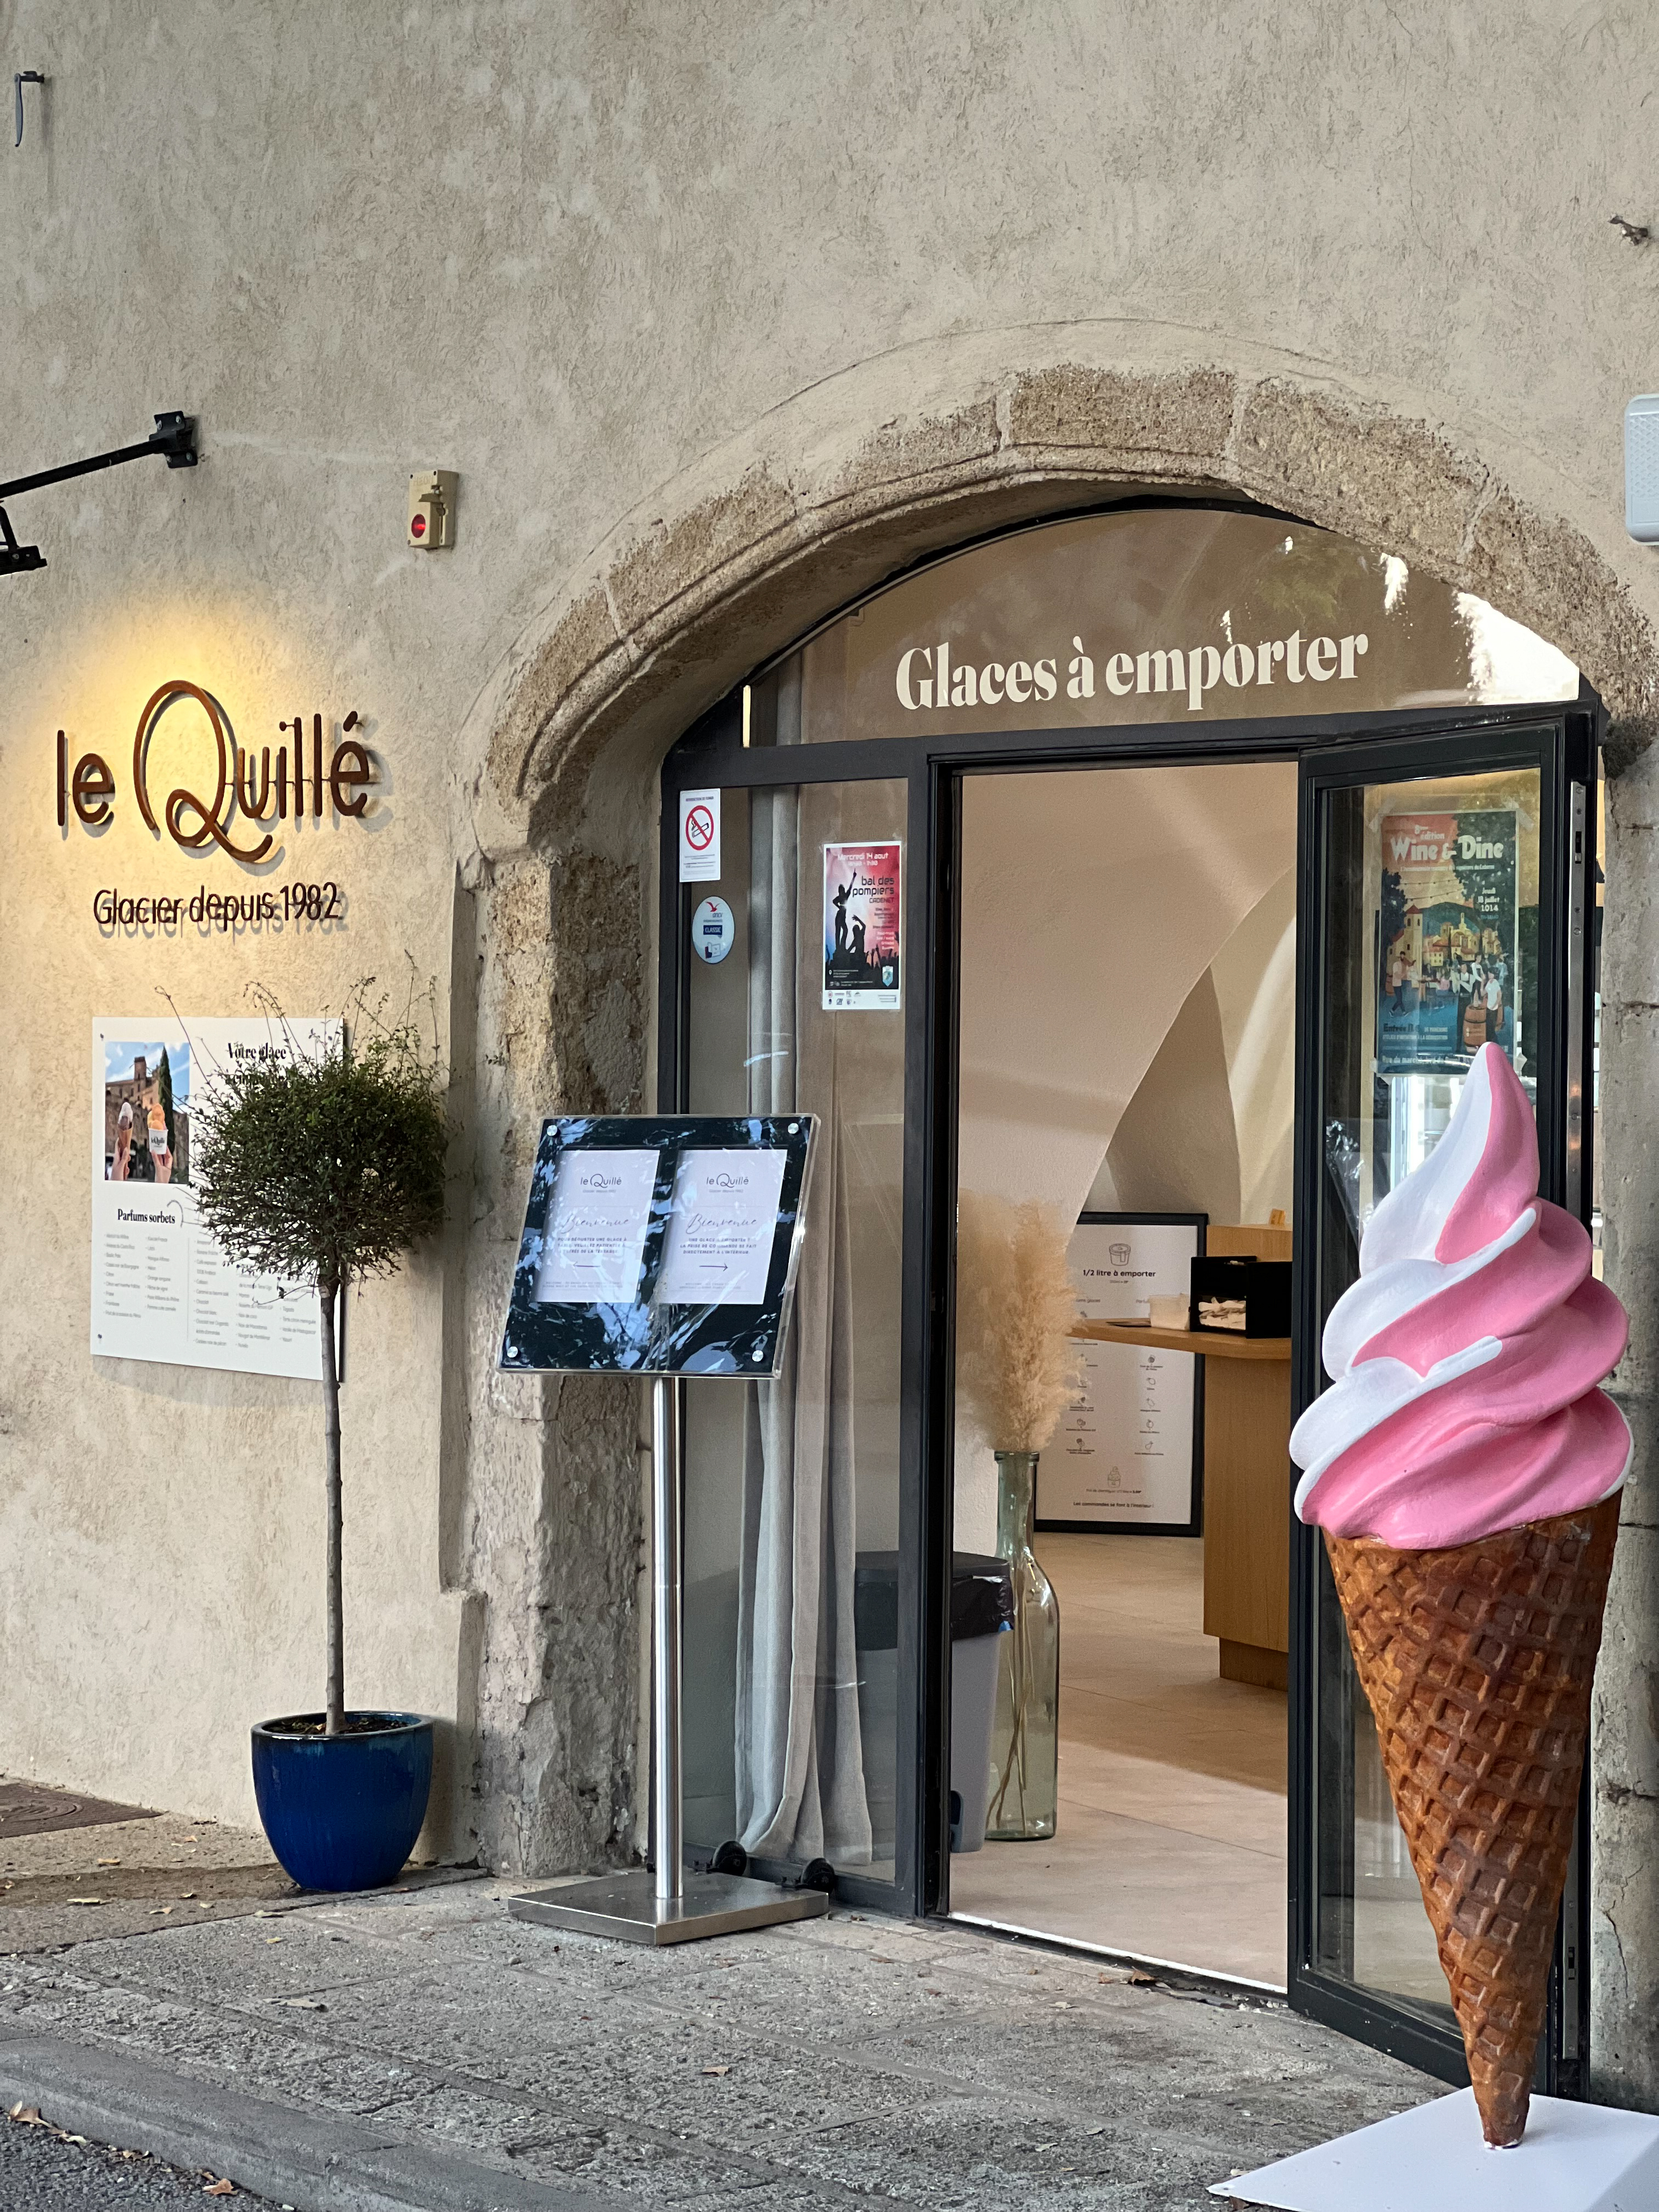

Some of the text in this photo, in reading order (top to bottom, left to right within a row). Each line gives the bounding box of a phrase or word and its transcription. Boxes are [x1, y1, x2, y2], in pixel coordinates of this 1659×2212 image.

[895, 629, 1369, 712] Glaces à emporter
[57, 679, 369, 862] le Quillé
[1390, 833, 1504, 862] Wine & Dine
[861, 875, 895, 885] bal des
[852, 884, 895, 898] pompiers
[94, 881, 338, 931] Glacier depuis 1982
[580, 1173, 622, 1188] le Quillé
[706, 1173, 749, 1188] le Quillé
[117, 1209, 176, 1224] Parfums sorbets
[561, 1213, 629, 1234] Bienvenue
[686, 1213, 758, 1234] Bienvenue
